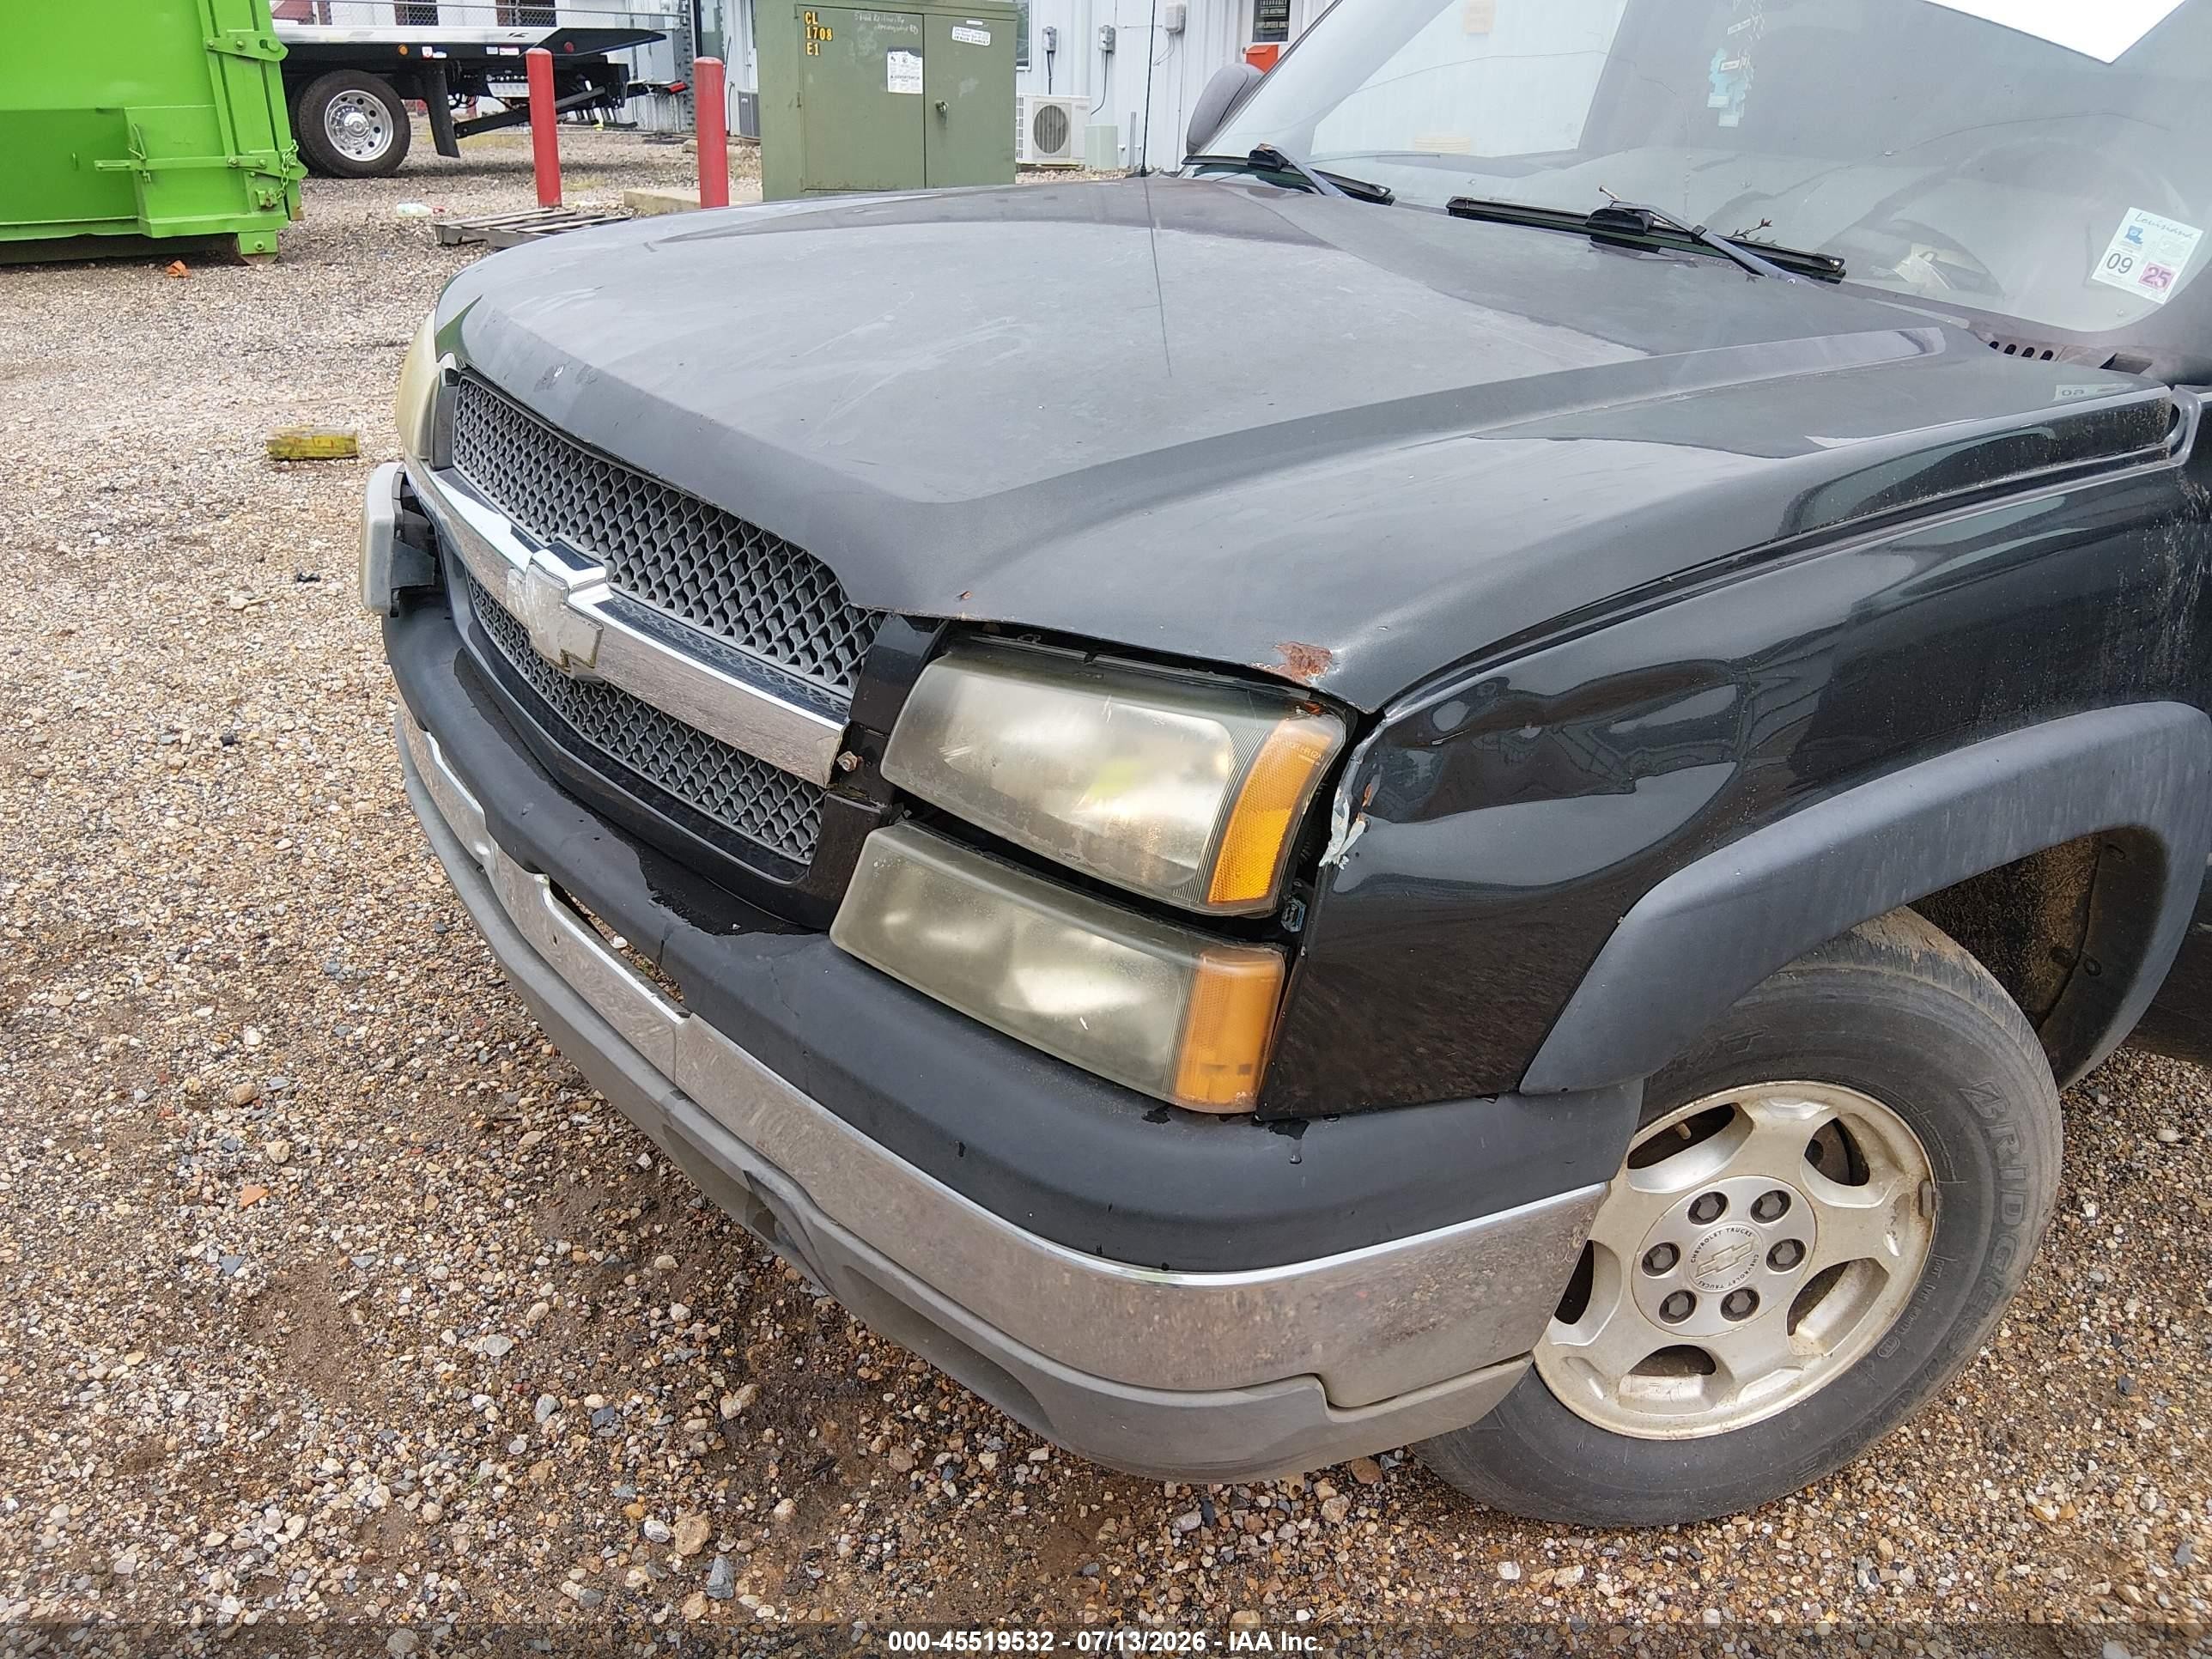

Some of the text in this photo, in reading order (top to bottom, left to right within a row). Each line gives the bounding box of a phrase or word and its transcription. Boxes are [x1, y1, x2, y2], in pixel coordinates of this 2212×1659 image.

[805, 11, 818, 25] CL
[806, 26, 833, 41] 1708
[806, 42, 819, 56] E1
[2106, 252, 2134, 275] 09
[2142, 266, 2172, 289] 25
[1691, 1227, 1753, 1263] CHEVROLET TRUCKS
